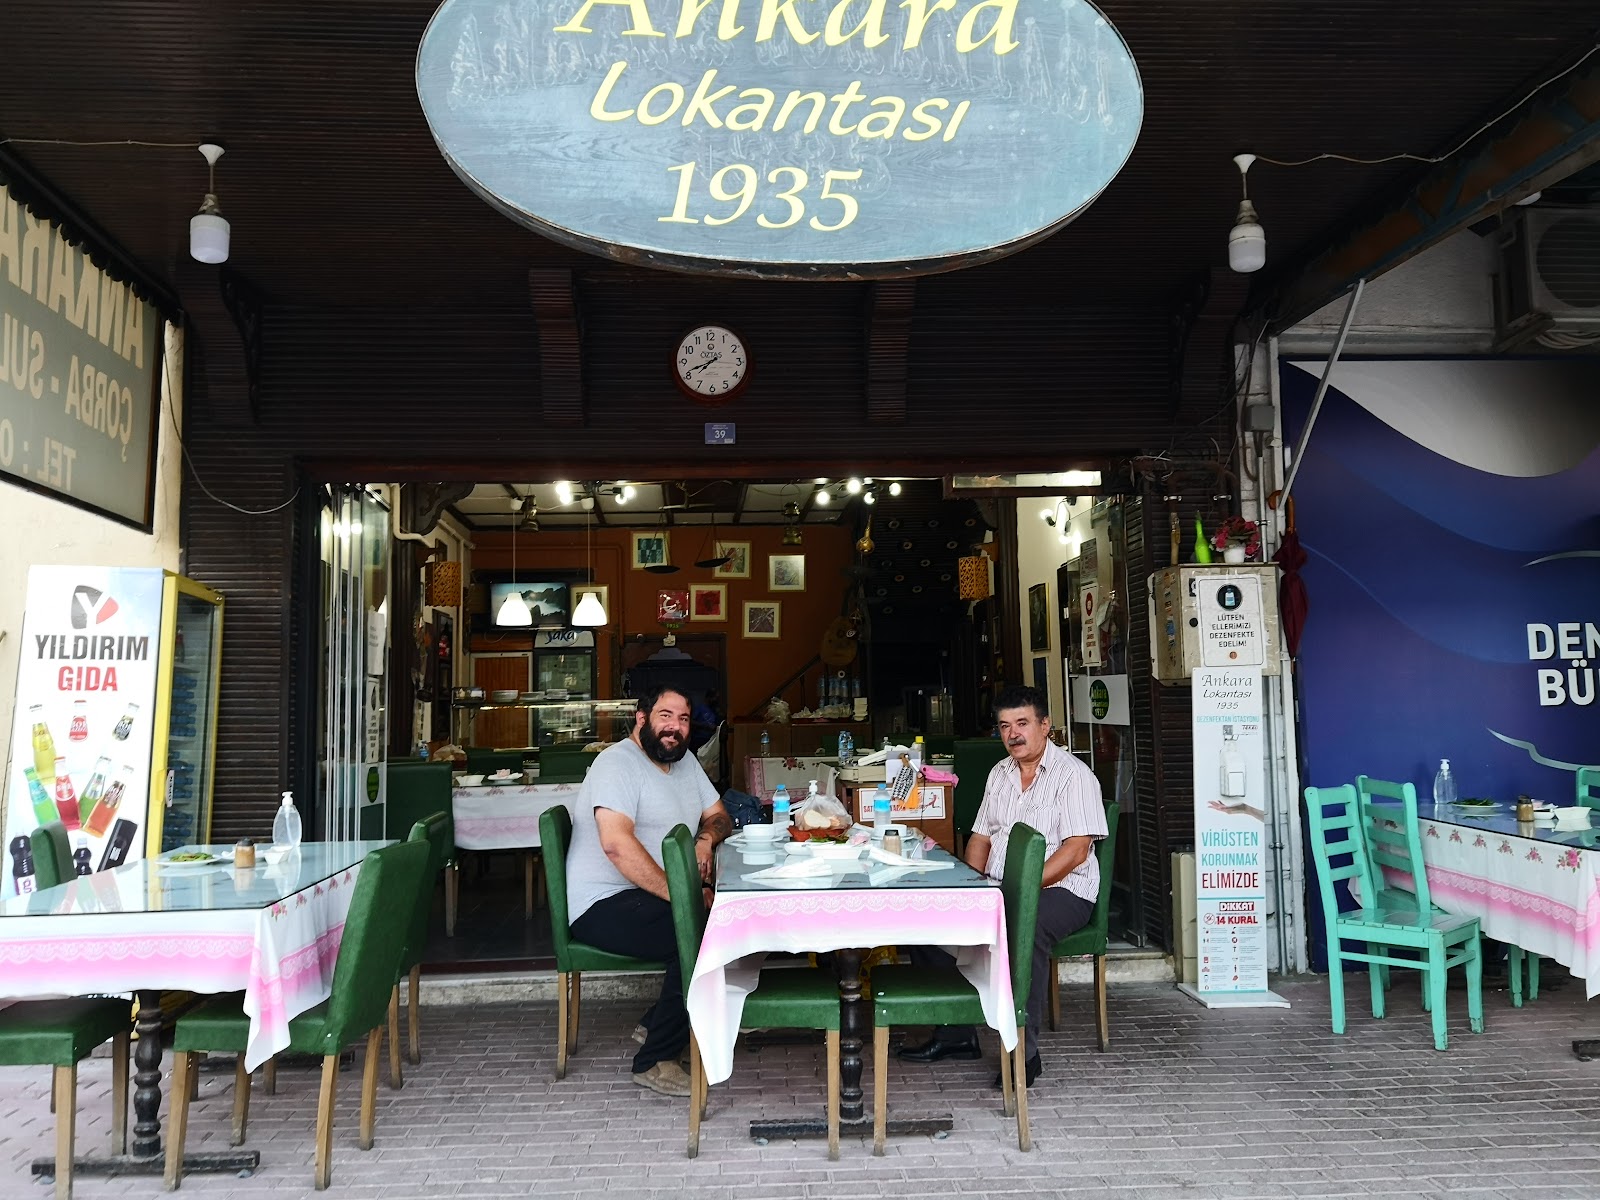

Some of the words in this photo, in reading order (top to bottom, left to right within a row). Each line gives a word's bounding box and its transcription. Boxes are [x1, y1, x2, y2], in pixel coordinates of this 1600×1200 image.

[589, 60, 970, 142] Lokantası
[656, 160, 863, 232] 1935
[695, 336, 701, 345] 11
[706, 332, 716, 341] 12
[685, 345, 694, 354] 10
[731, 344, 738, 353] 2
[681, 358, 688, 366] 9
[736, 358, 742, 366] 3
[685, 371, 692, 380] 8
[732, 370, 739, 379] 4
[696, 380, 703, 389] 7
[709, 384, 716, 393] 6
[722, 380, 729, 389] 5
[714, 430, 726, 439] 39
[1217, 614, 1245, 622] LÜTFEN
[1209, 631, 1255, 640] DEZENFEKTE
[35, 634, 149, 661] YILDIRIM
[57, 665, 118, 692] GIDA
[1201, 671, 1253, 687] Ankara
[1537, 659, 1600, 706] BÜ
[1203, 688, 1252, 699] Lokantası
[1216, 702, 1239, 710] 1935
[1201, 829, 1259, 847] VİRÜSTEN
[1201, 852, 1259, 867] KORUNMAK
[1202, 869, 1259, 889] ELİMİZDE
[1216, 915, 1226, 925] 14
[1227, 915, 1259, 925] KURAL
